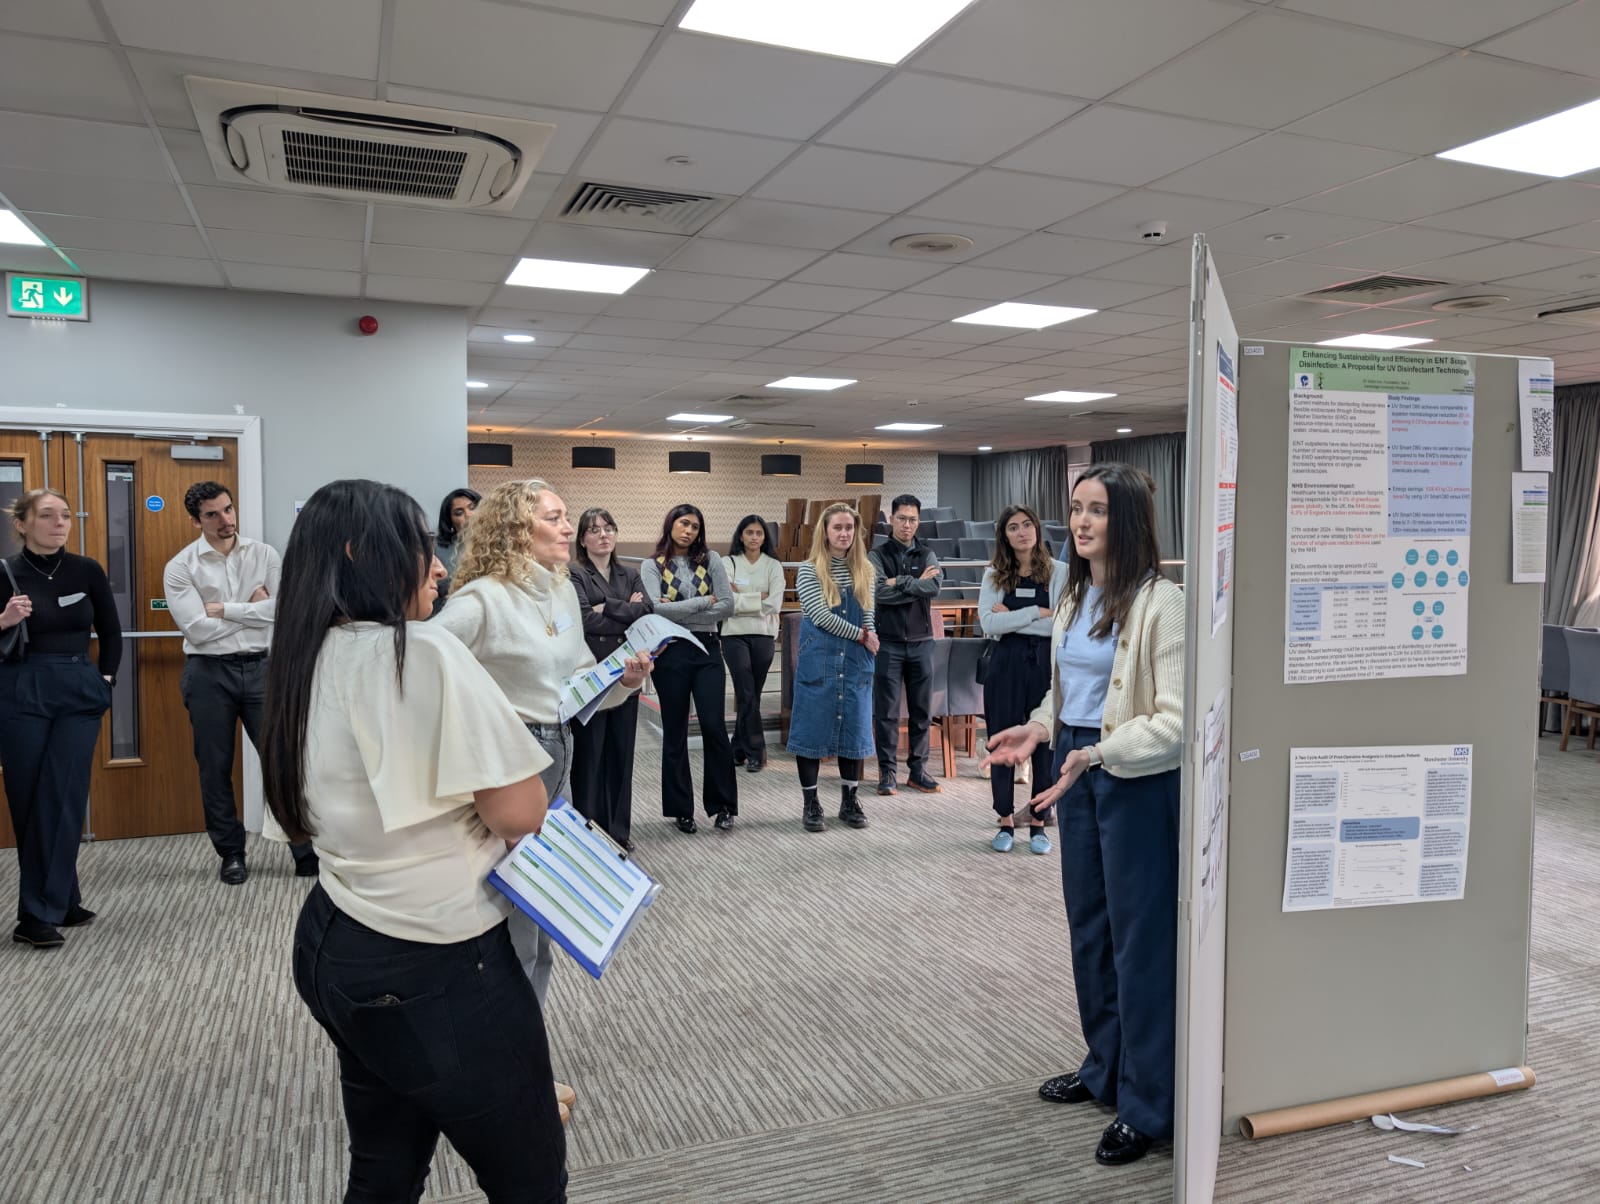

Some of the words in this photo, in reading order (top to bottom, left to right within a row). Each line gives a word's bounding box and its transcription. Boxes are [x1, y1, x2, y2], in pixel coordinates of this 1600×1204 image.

[1302, 351, 1337, 361] Enhancing
[1338, 353, 1380, 363] Sustainability
[1395, 356, 1425, 365] Efficiency
[1299, 361, 1340, 370] Disinfection:
[1348, 364, 1374, 373] Proposal
[1397, 366, 1434, 374] Disinfectant
[1436, 368, 1469, 376] Technology
